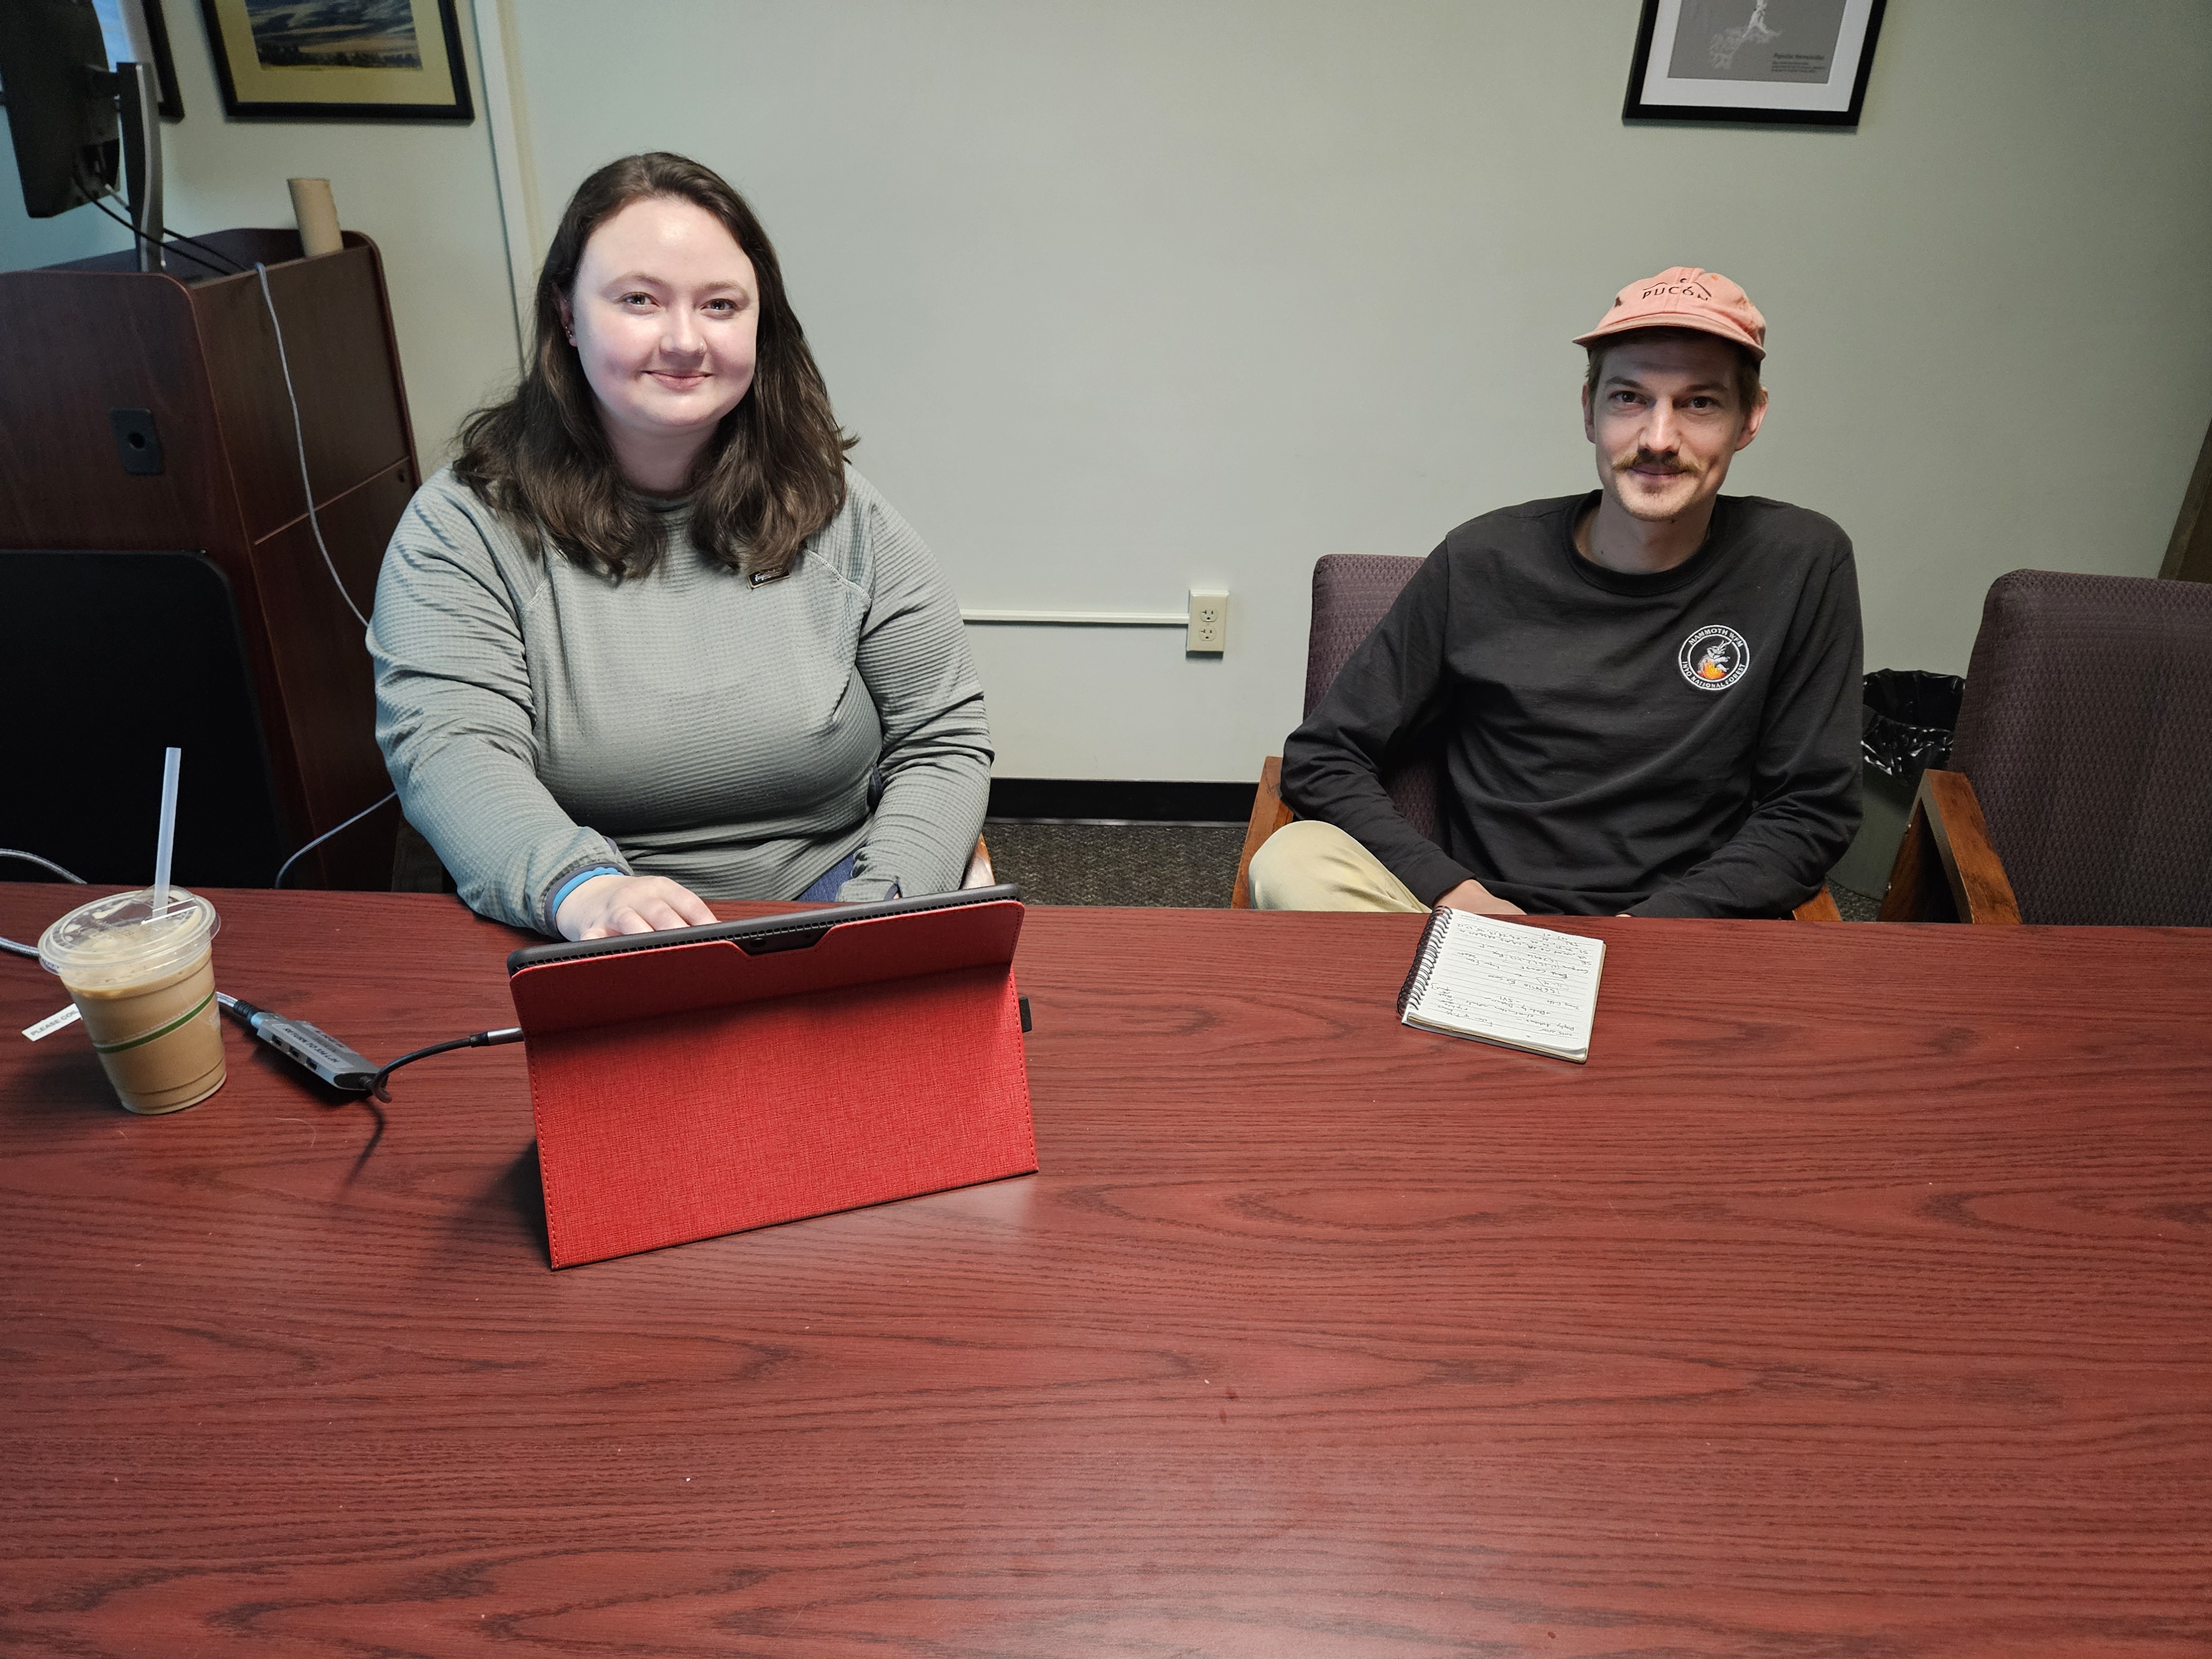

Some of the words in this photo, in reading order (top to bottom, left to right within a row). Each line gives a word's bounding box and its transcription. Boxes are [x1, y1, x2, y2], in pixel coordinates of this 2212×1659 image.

[1689, 628, 1728, 645] MAMMOTH
[1729, 632, 1744, 647] WFM
[1682, 661, 1692, 676] INYO
[1691, 676, 1725, 688] NATIONAL
[1725, 664, 1746, 685] FOREST
[30, 1019, 61, 1036] PLEASE
[61, 1010, 79, 1020] COIL
